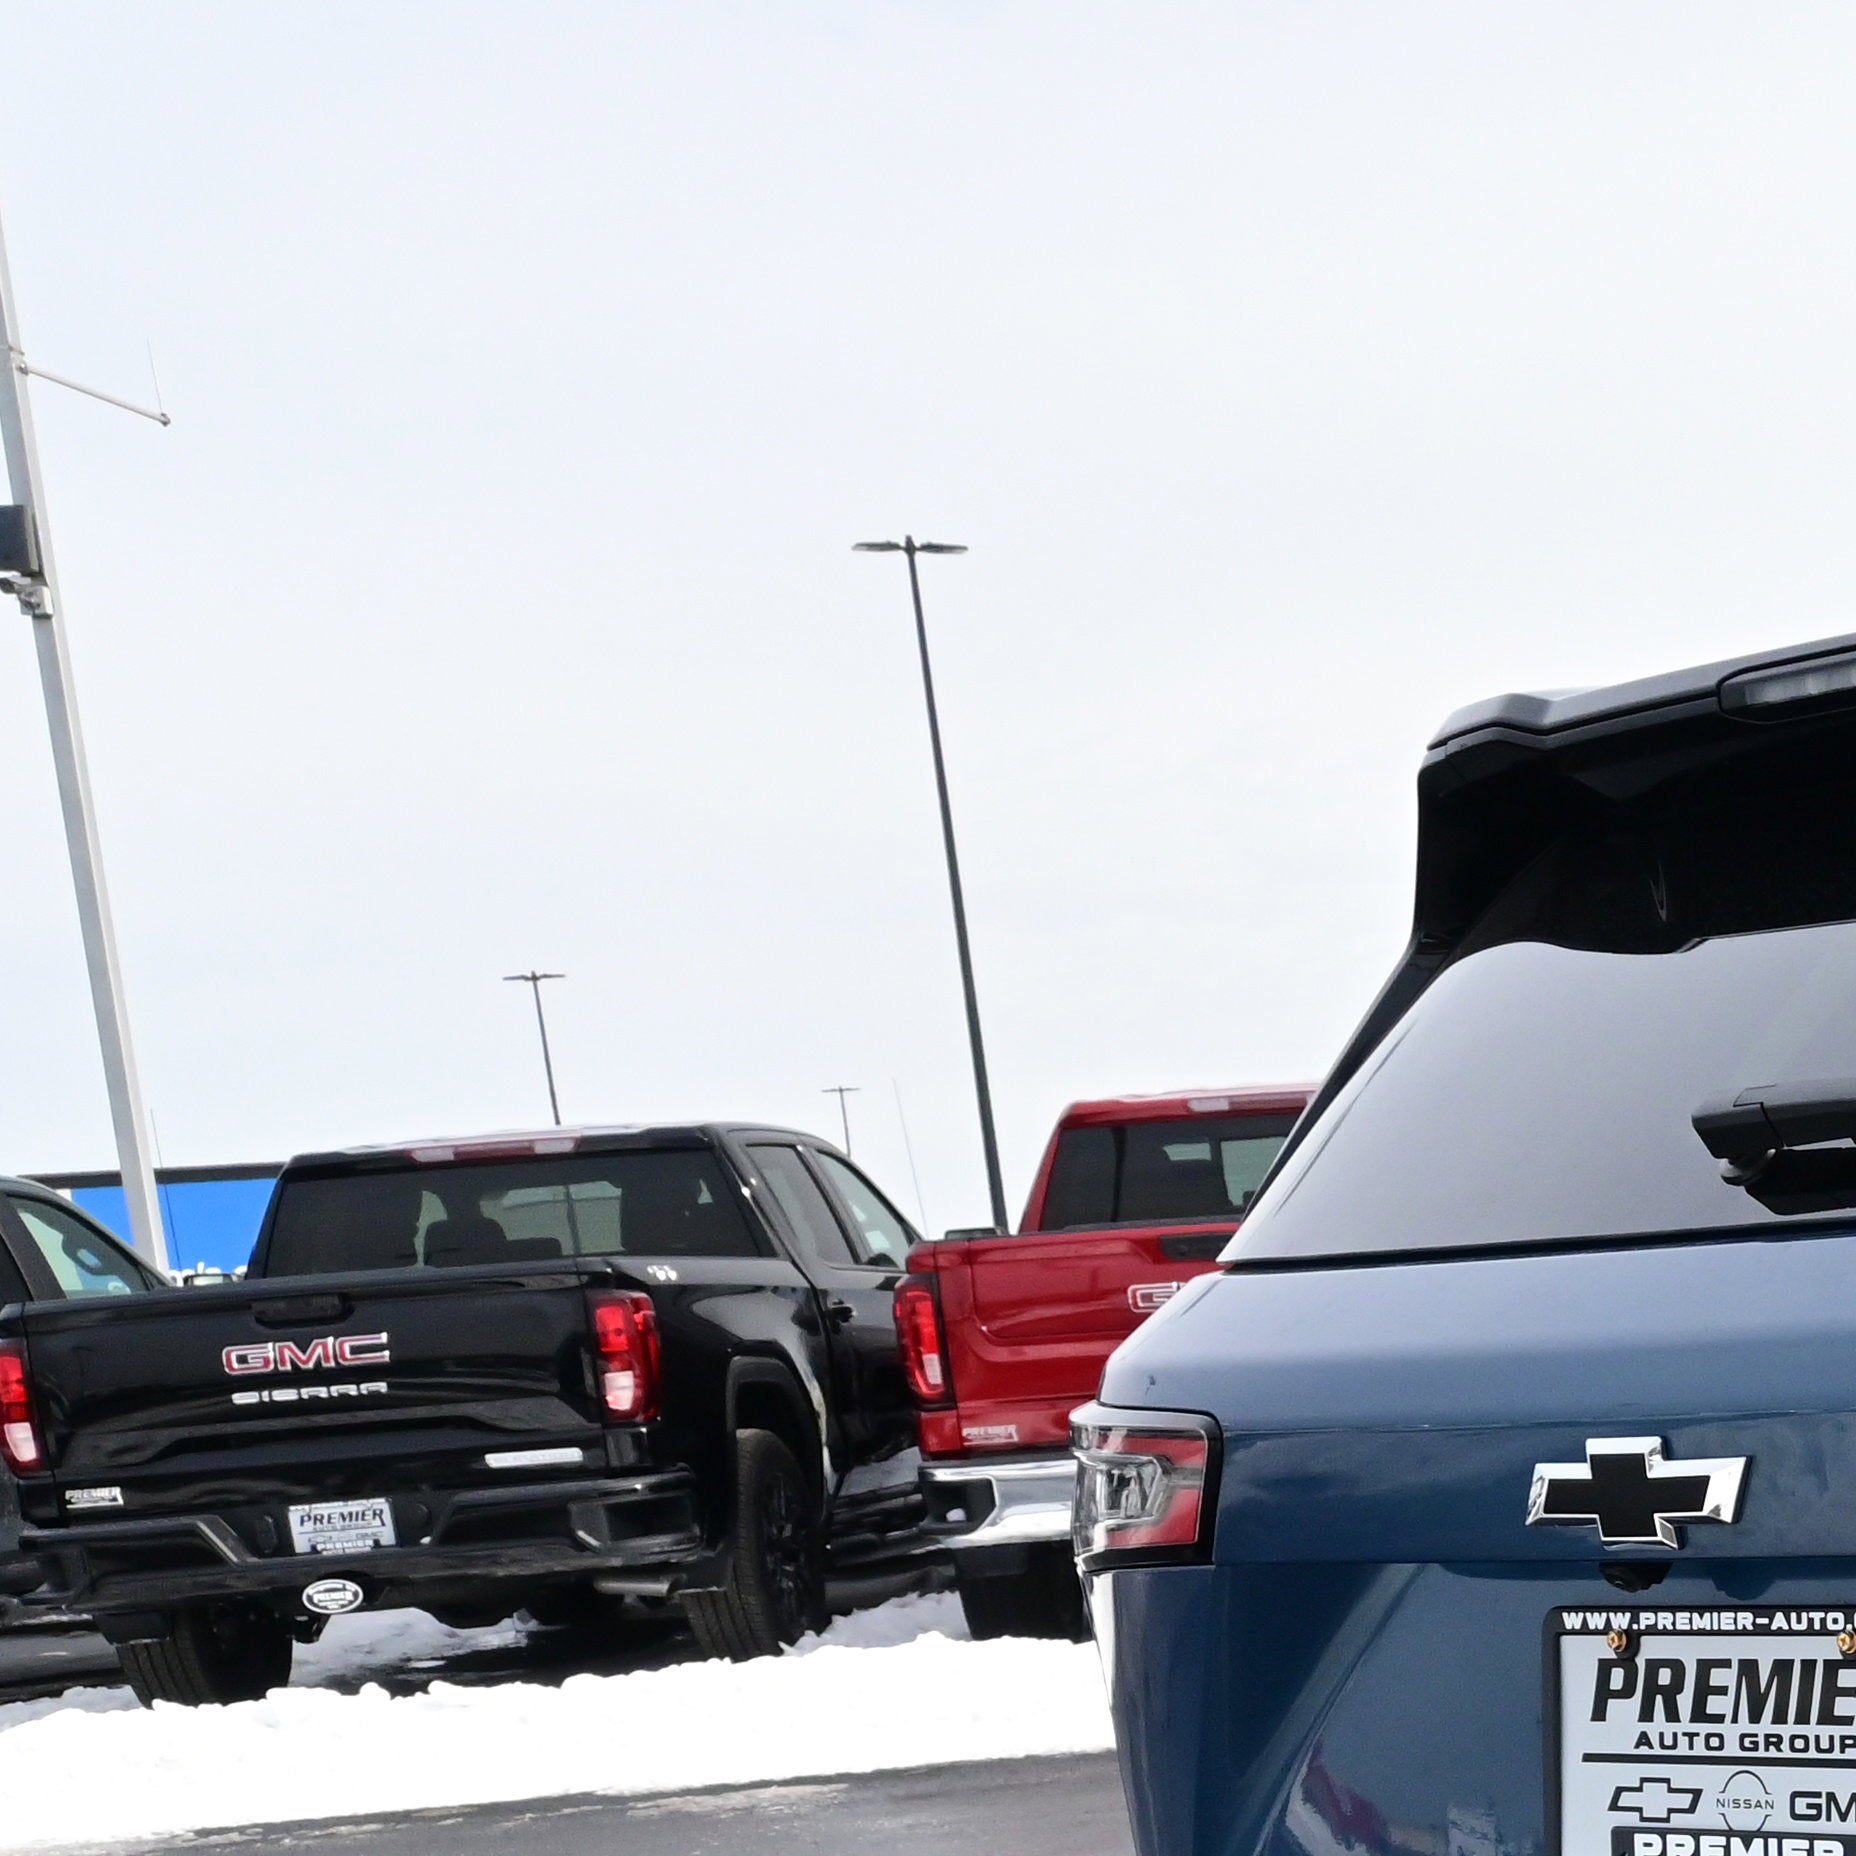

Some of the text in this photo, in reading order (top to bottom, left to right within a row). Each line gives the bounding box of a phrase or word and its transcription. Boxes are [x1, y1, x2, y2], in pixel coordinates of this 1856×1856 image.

[222, 1331, 391, 1376] GMC
[299, 1508, 386, 1527] PREMIER
[1634, 1730, 1726, 1752] AUTO
[1715, 1797, 1775, 1810] NISSAN
